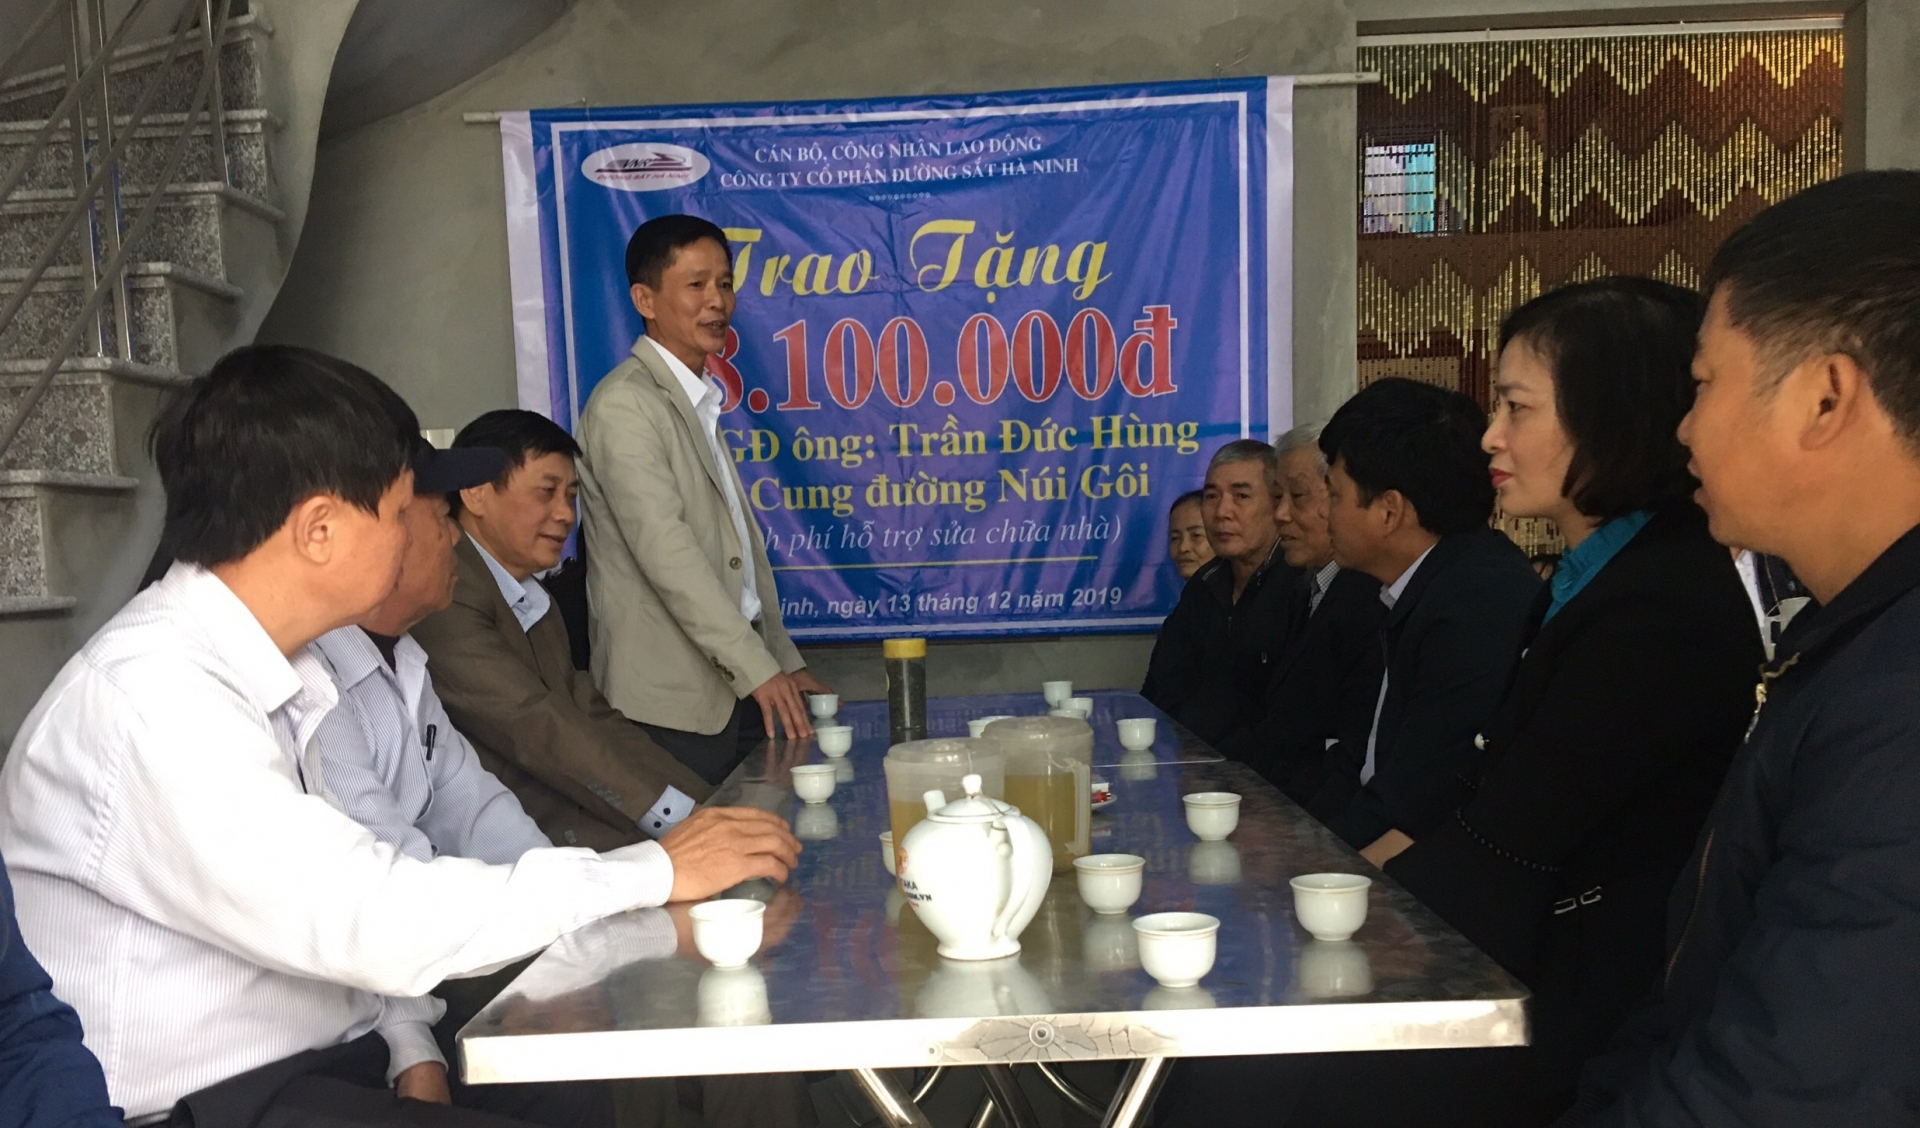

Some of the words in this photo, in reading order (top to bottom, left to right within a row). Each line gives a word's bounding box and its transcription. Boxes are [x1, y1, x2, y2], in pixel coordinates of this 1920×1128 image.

[754, 143, 792, 163] CÁN
[797, 141, 828, 165] BỘ,
[831, 140, 885, 161] CÔNG
[889, 138, 941, 159] NHÂN
[946, 139, 984, 156] LAO
[988, 133, 1042, 156] ĐỘNG
[720, 169, 773, 188] CÔNG
[776, 171, 802, 187] TY
[806, 163, 833, 186] CỔ
[836, 162, 888, 184] PHẦN
[891, 162, 957, 184] ĐƯỜNG
[961, 157, 997, 179] SẮT
[1001, 157, 1027, 176] HÀ
[1032, 157, 1079, 174] NINH
[721, 227, 880, 297] Trao
[909, 218, 1113, 304] Tặng
[792, 426, 875, 468] ông:
[889, 414, 988, 458] Trần
[998, 417, 1078, 453] Đức
[1089, 412, 1200, 455] Hùng
[750, 477, 855, 518] Cung
[865, 471, 987, 514] đường
[997, 466, 1068, 502] Núi
[1080, 462, 1150, 500] Gôi
[788, 524, 835, 558] phí
[840, 520, 876, 549] hỗ
[882, 527, 924, 551] trợ
[929, 519, 977, 546] sửa
[985, 518, 1051, 544] chữa
[1059, 514, 1122, 545] nhà)
[781, 597, 819, 618] inh,
[827, 595, 880, 619] ngày
[887, 594, 911, 613] 13
[917, 592, 979, 615] tháng
[987, 590, 1012, 610] 12
[1018, 589, 1064, 609] năm
[1071, 586, 1122, 607] 2019
